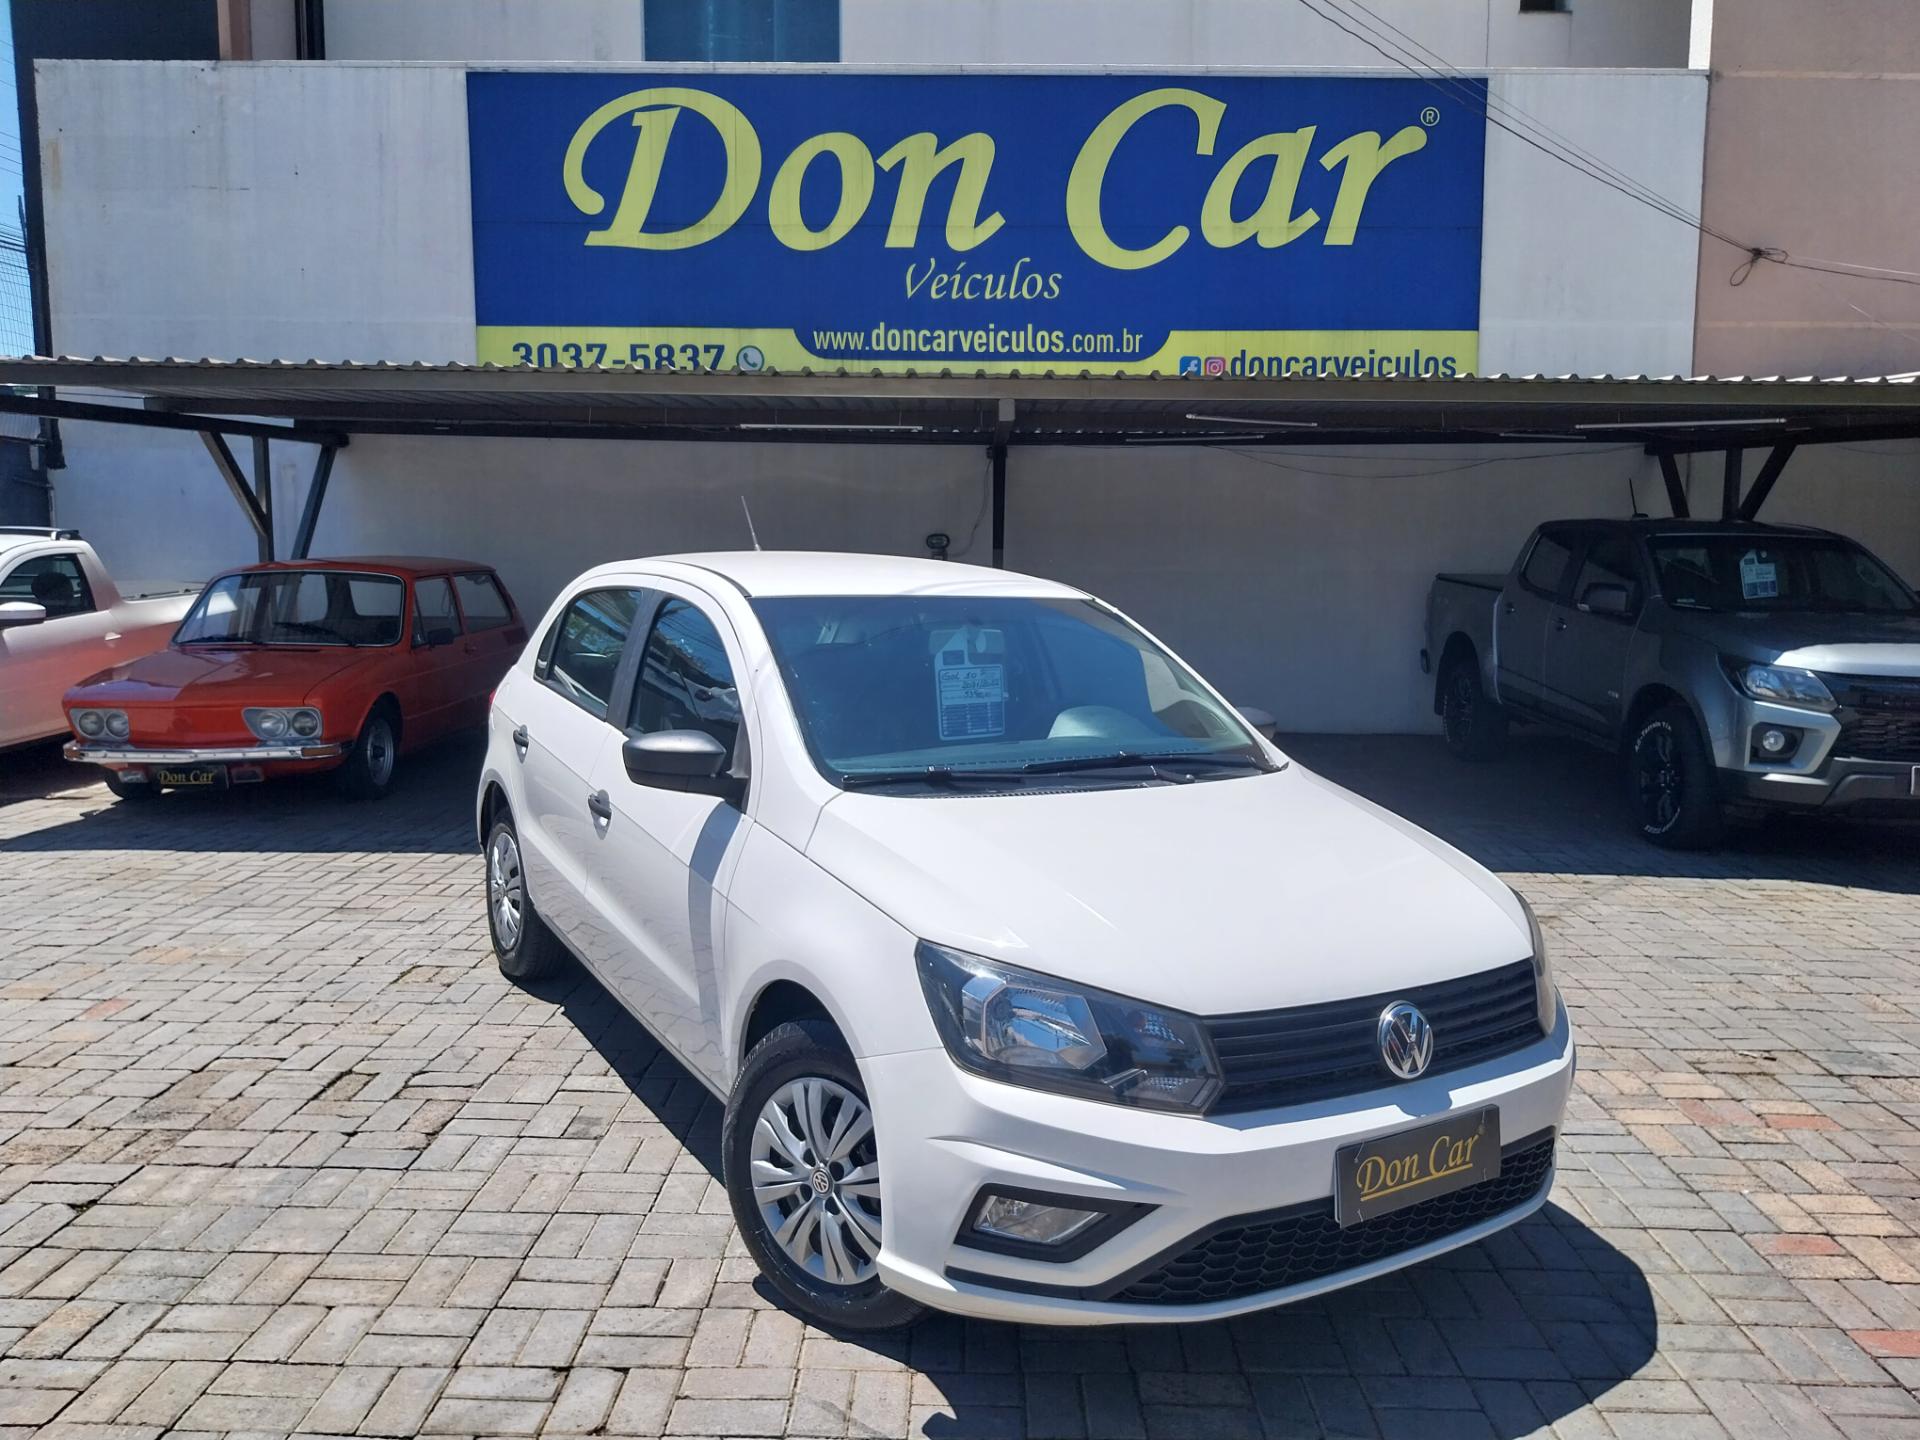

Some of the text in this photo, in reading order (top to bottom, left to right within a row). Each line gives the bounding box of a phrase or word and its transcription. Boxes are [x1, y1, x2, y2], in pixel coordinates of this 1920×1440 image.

[563, 87, 1006, 252] Don
[1066, 88, 1428, 270] Car
[904, 257, 1063, 300] Veículos
[813, 322, 1143, 353] www.doncarveiculos.com.br
[512, 342, 726, 371] 3037-5837
[1230, 349, 1457, 378] doncarveiculos
[157, 770, 215, 784] Don Car
[1356, 1134, 1480, 1195] Don Car
